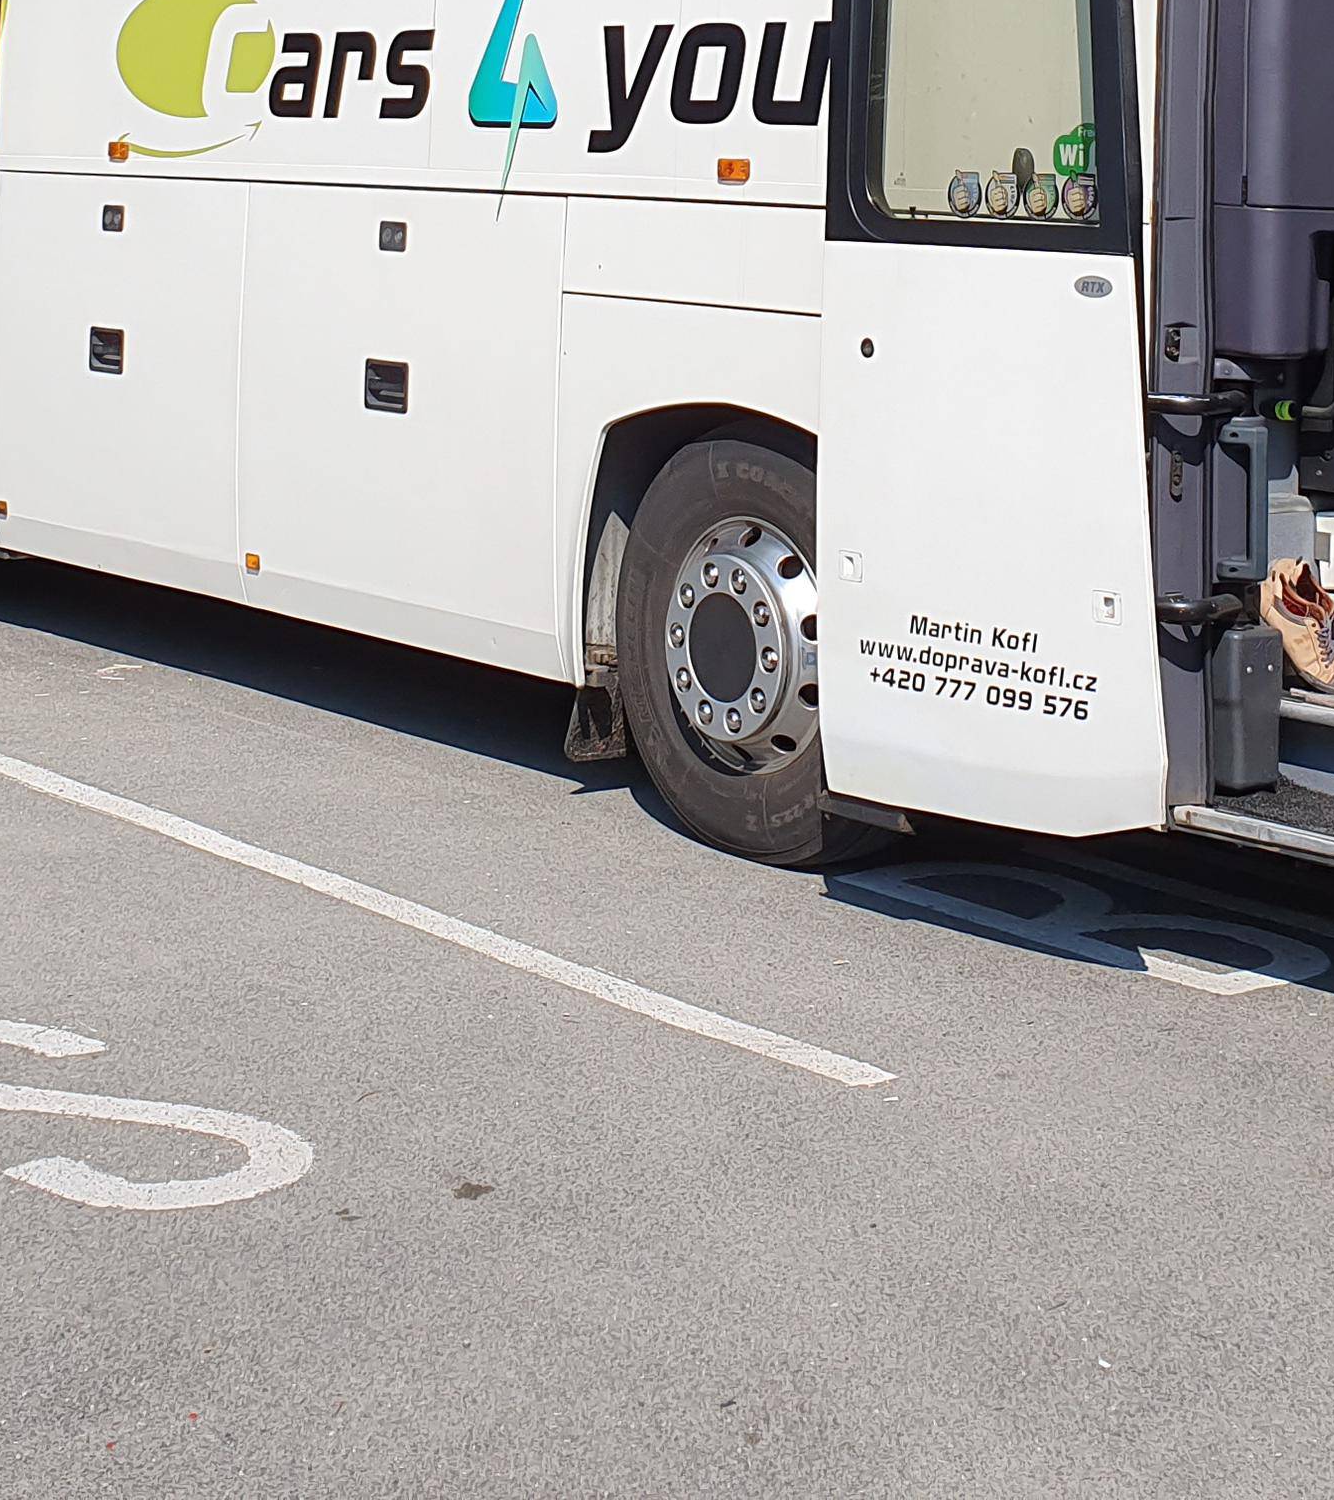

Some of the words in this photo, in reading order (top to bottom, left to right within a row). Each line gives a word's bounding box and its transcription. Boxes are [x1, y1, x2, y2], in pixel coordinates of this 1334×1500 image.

[587, 21, 833, 154] you
[1080, 280, 1105, 293] RTX
[909, 614, 982, 645] Martin
[991, 627, 1038, 653] Kofl
[859, 639, 1098, 693] www.doprava-kofl.cz
[870, 667, 926, 693] +420
[935, 674, 977, 701] 777
[986, 685, 1033, 711] 099
[1042, 694, 1089, 721] 576
